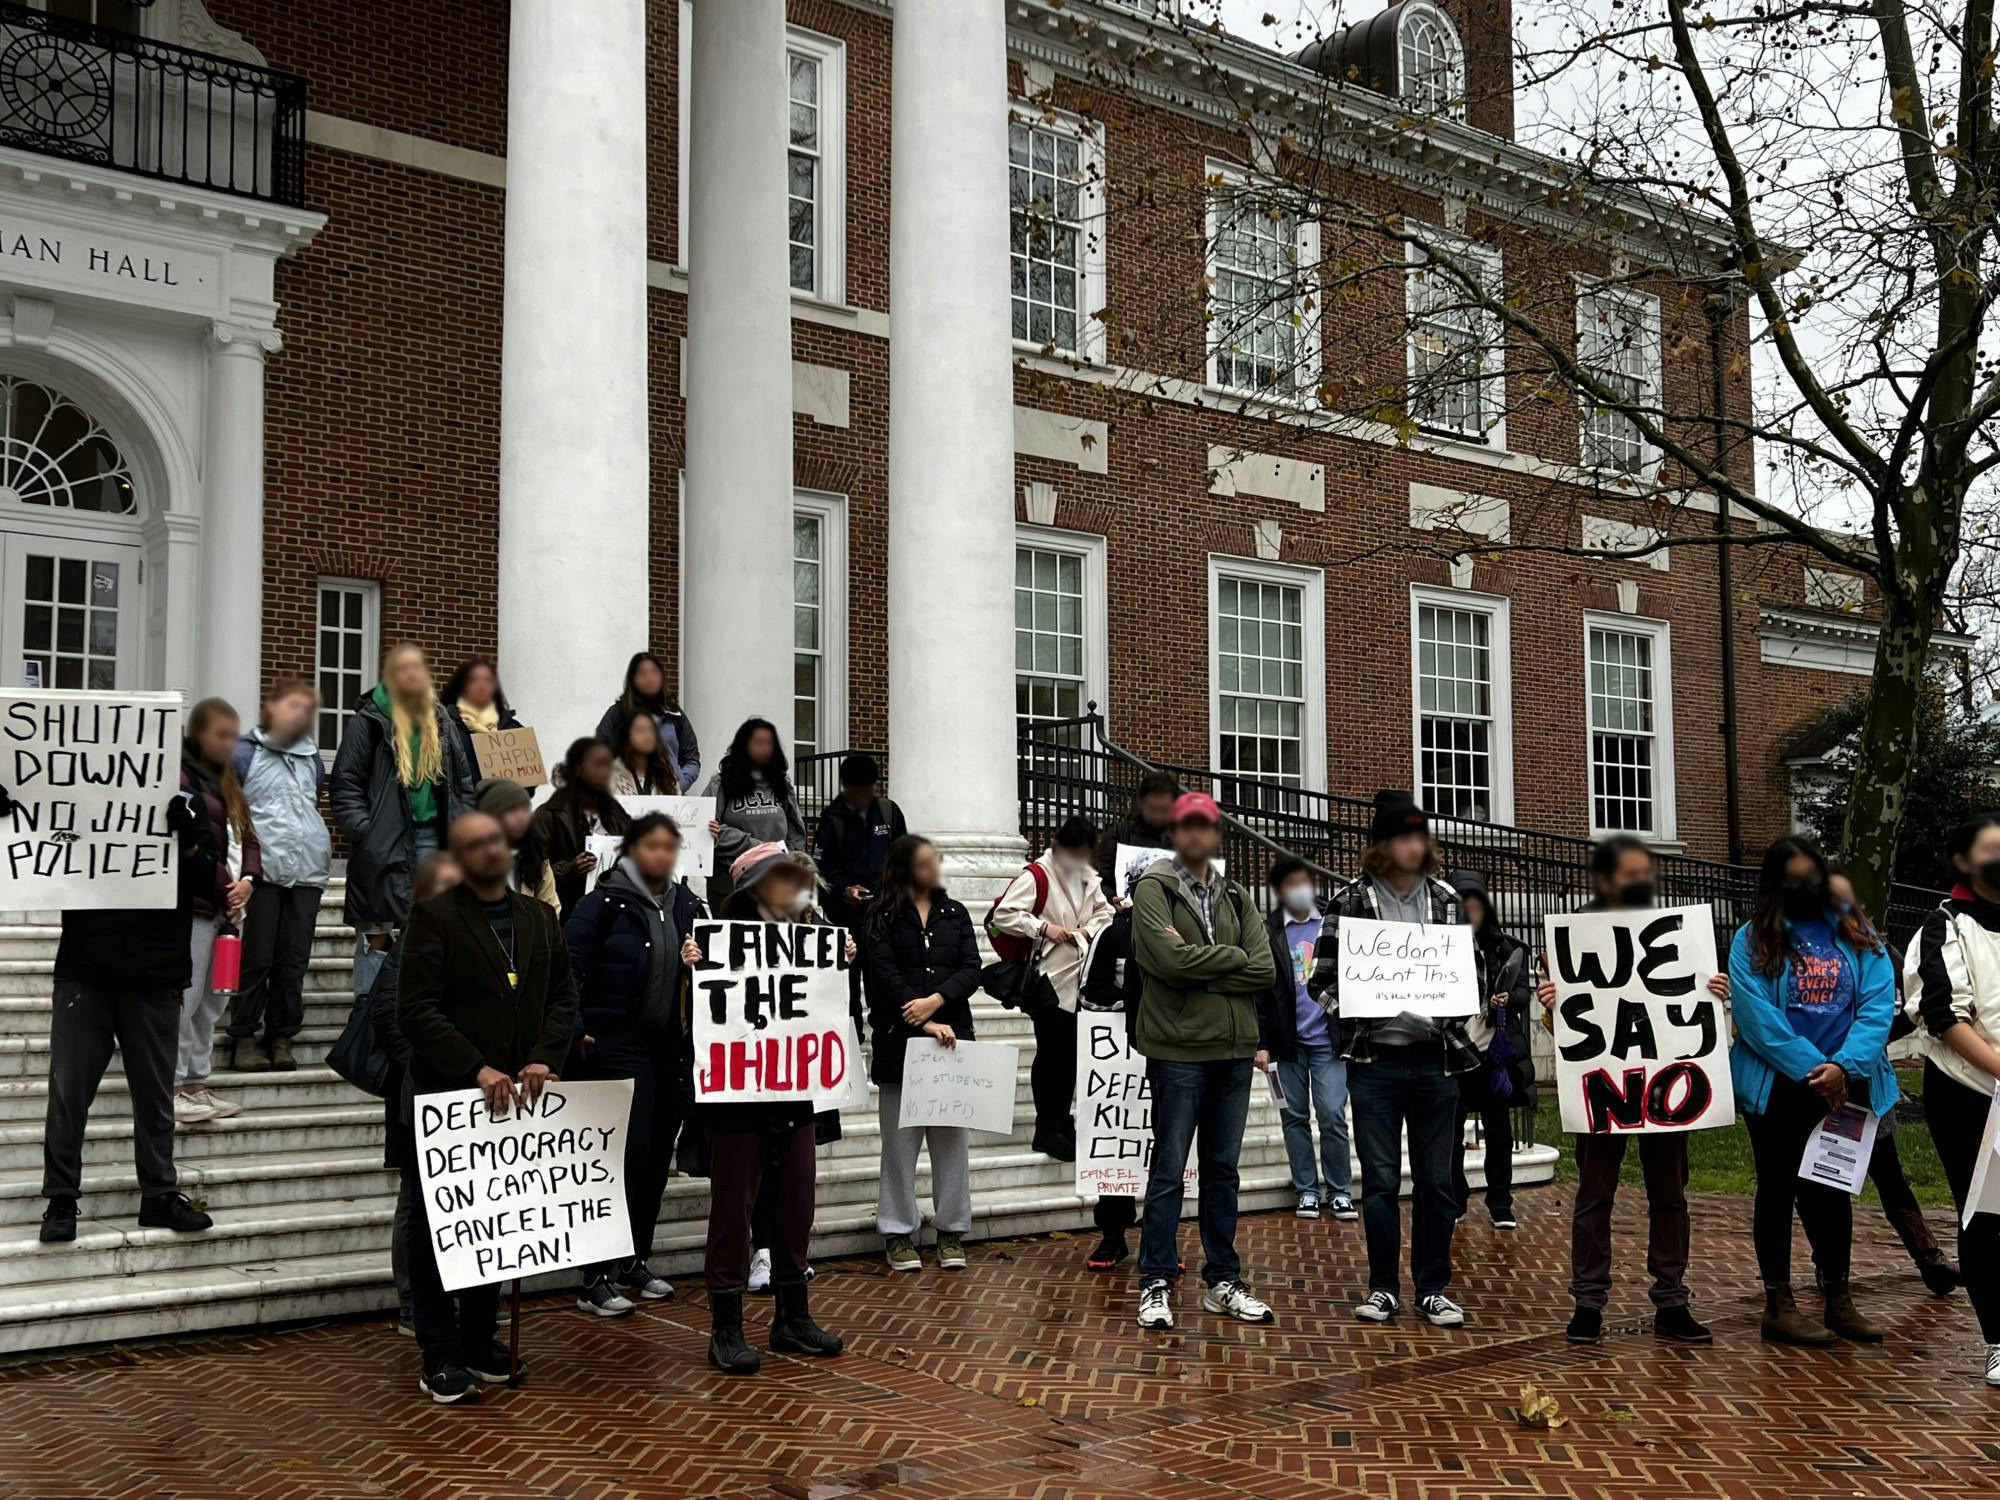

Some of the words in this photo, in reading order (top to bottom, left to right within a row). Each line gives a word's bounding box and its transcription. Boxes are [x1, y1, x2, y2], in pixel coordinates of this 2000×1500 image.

[0, 230, 61, 264] AN
[89, 247, 178, 285] HALL
[483, 747, 537, 769] JHPD
[488, 733, 515, 750] NO
[15, 750, 164, 788] DOWN!
[11, 800, 76, 833] NO
[8, 840, 170, 880] POLICE!
[695, 923, 850, 972] CANCEL
[1347, 929, 1392, 957] We
[1397, 931, 1455, 959] don't
[1554, 914, 1696, 997] WE
[1345, 965, 1416, 982] Want
[1414, 963, 1459, 983] This
[1798, 976, 1837, 990] EVERY
[698, 974, 809, 1025] THE
[1414, 991, 1446, 1001] simple
[1558, 993, 1717, 1062] SAY
[700, 1030, 845, 1095] JHUPD
[932, 1073, 993, 1089] STUDENTS
[1088, 1069, 1153, 1101] DEFE
[1582, 1061, 1713, 1134] NO
[927, 1099, 975, 1120] JHPD
[1094, 1103, 1154, 1129] KILL
[426, 1127, 616, 1179] DEMOCRACY
[435, 1180, 474, 1213] ON
[486, 1159, 615, 1201] CAMPUS,
[1080, 1168, 1139, 1180] CANCEL
[1097, 1181, 1141, 1193] PRIVATE
[435, 1206, 556, 1252] CANCEL
[558, 1198, 612, 1229] THE
[475, 1232, 572, 1278] PLAN!
